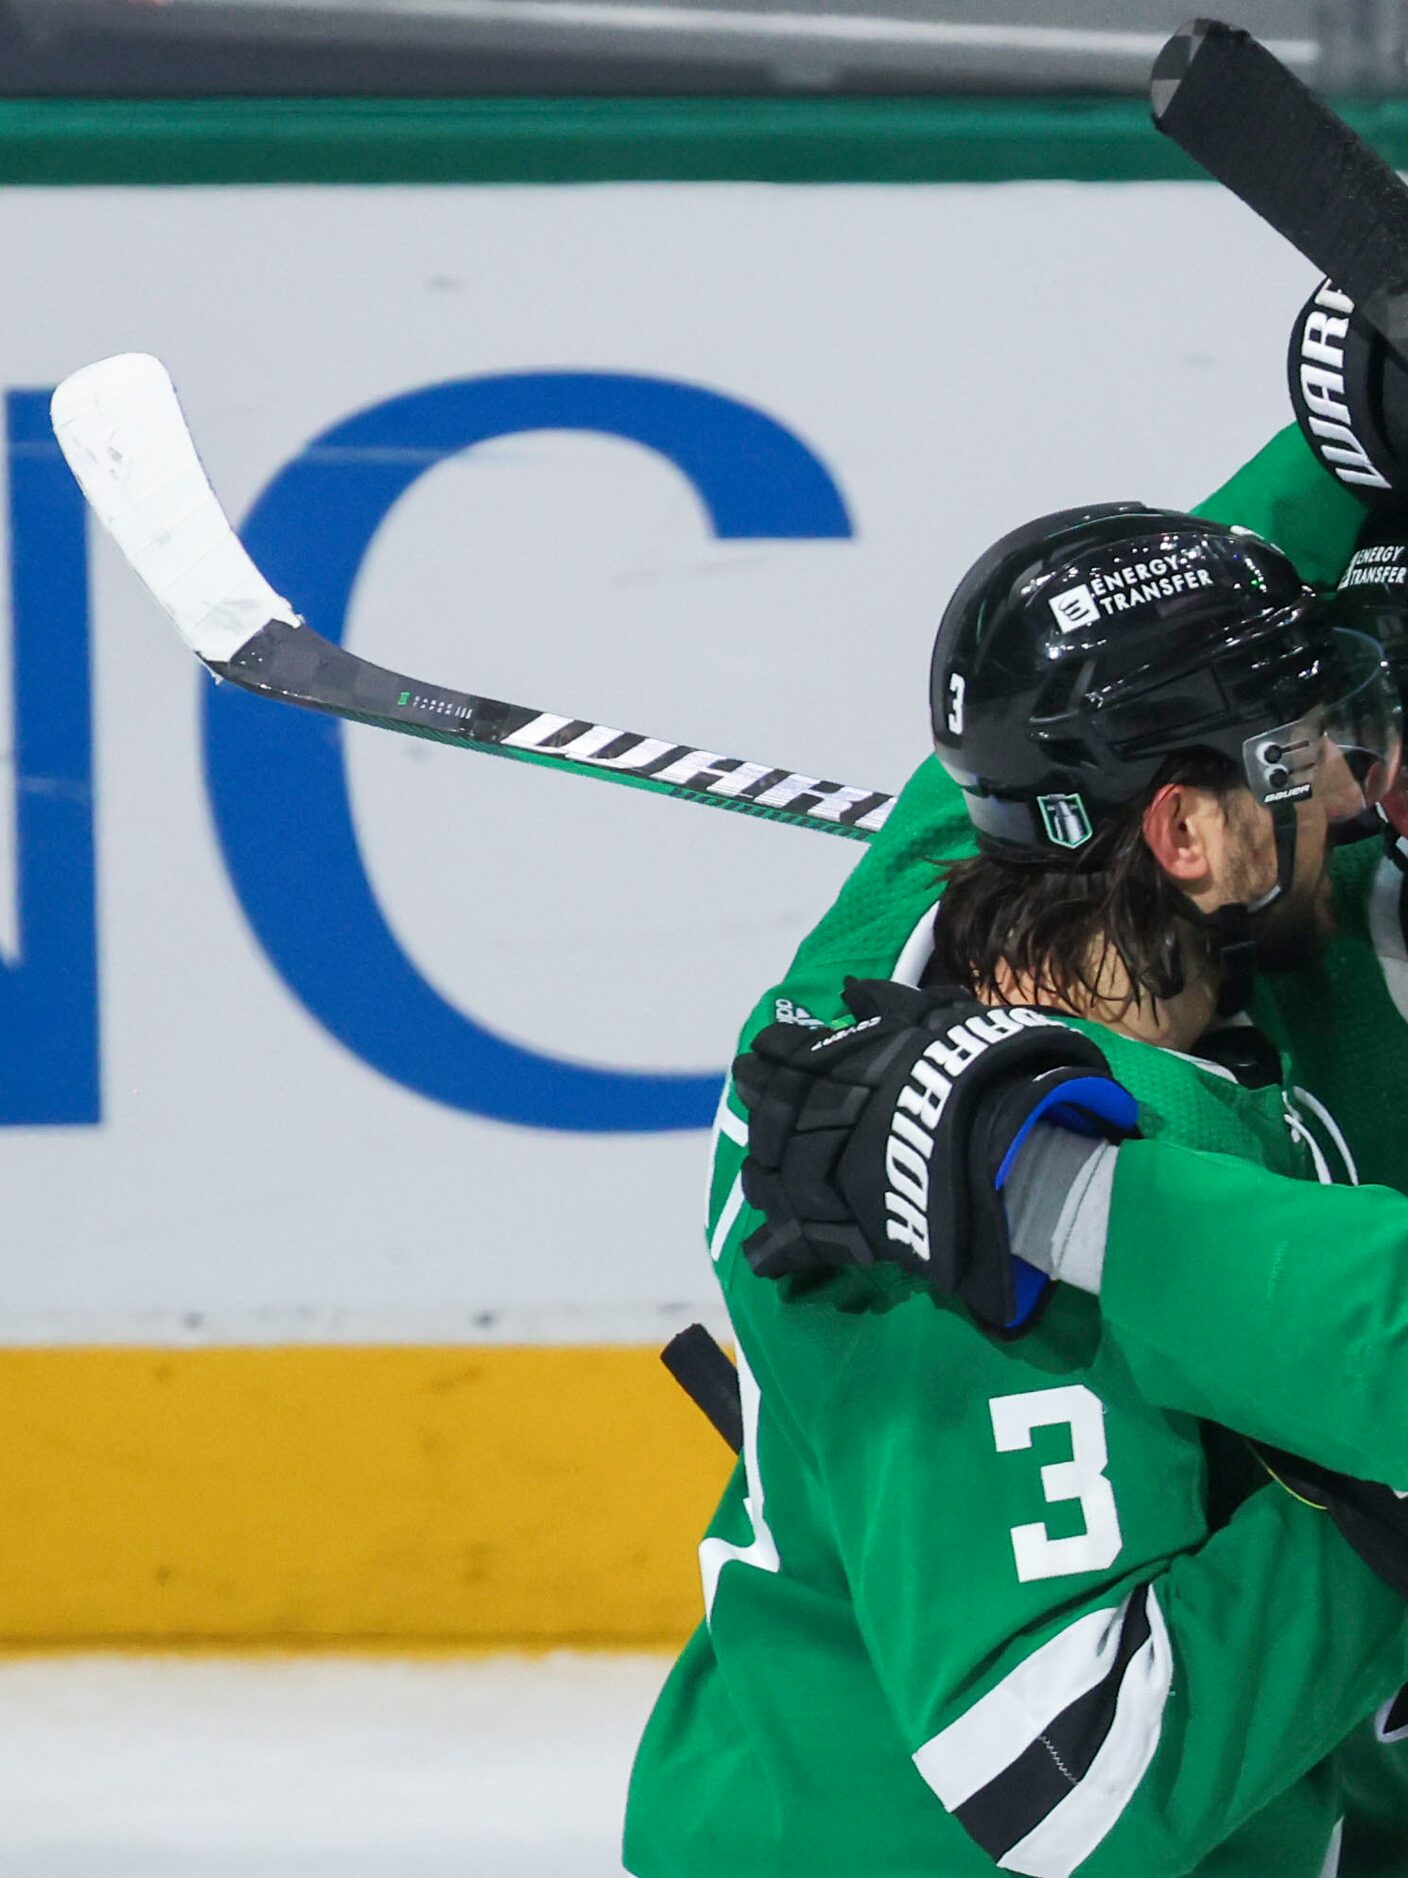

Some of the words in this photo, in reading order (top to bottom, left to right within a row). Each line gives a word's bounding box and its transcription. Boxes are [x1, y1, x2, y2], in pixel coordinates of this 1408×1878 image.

[1090, 556, 1181, 595] ENERGY
[1349, 565, 1408, 586] TRANSFER
[1355, 545, 1406, 565] ENERGY
[1100, 568, 1214, 616] TRANSFER
[948, 672, 966, 735] 3
[988, 1384, 1123, 1583] 3
